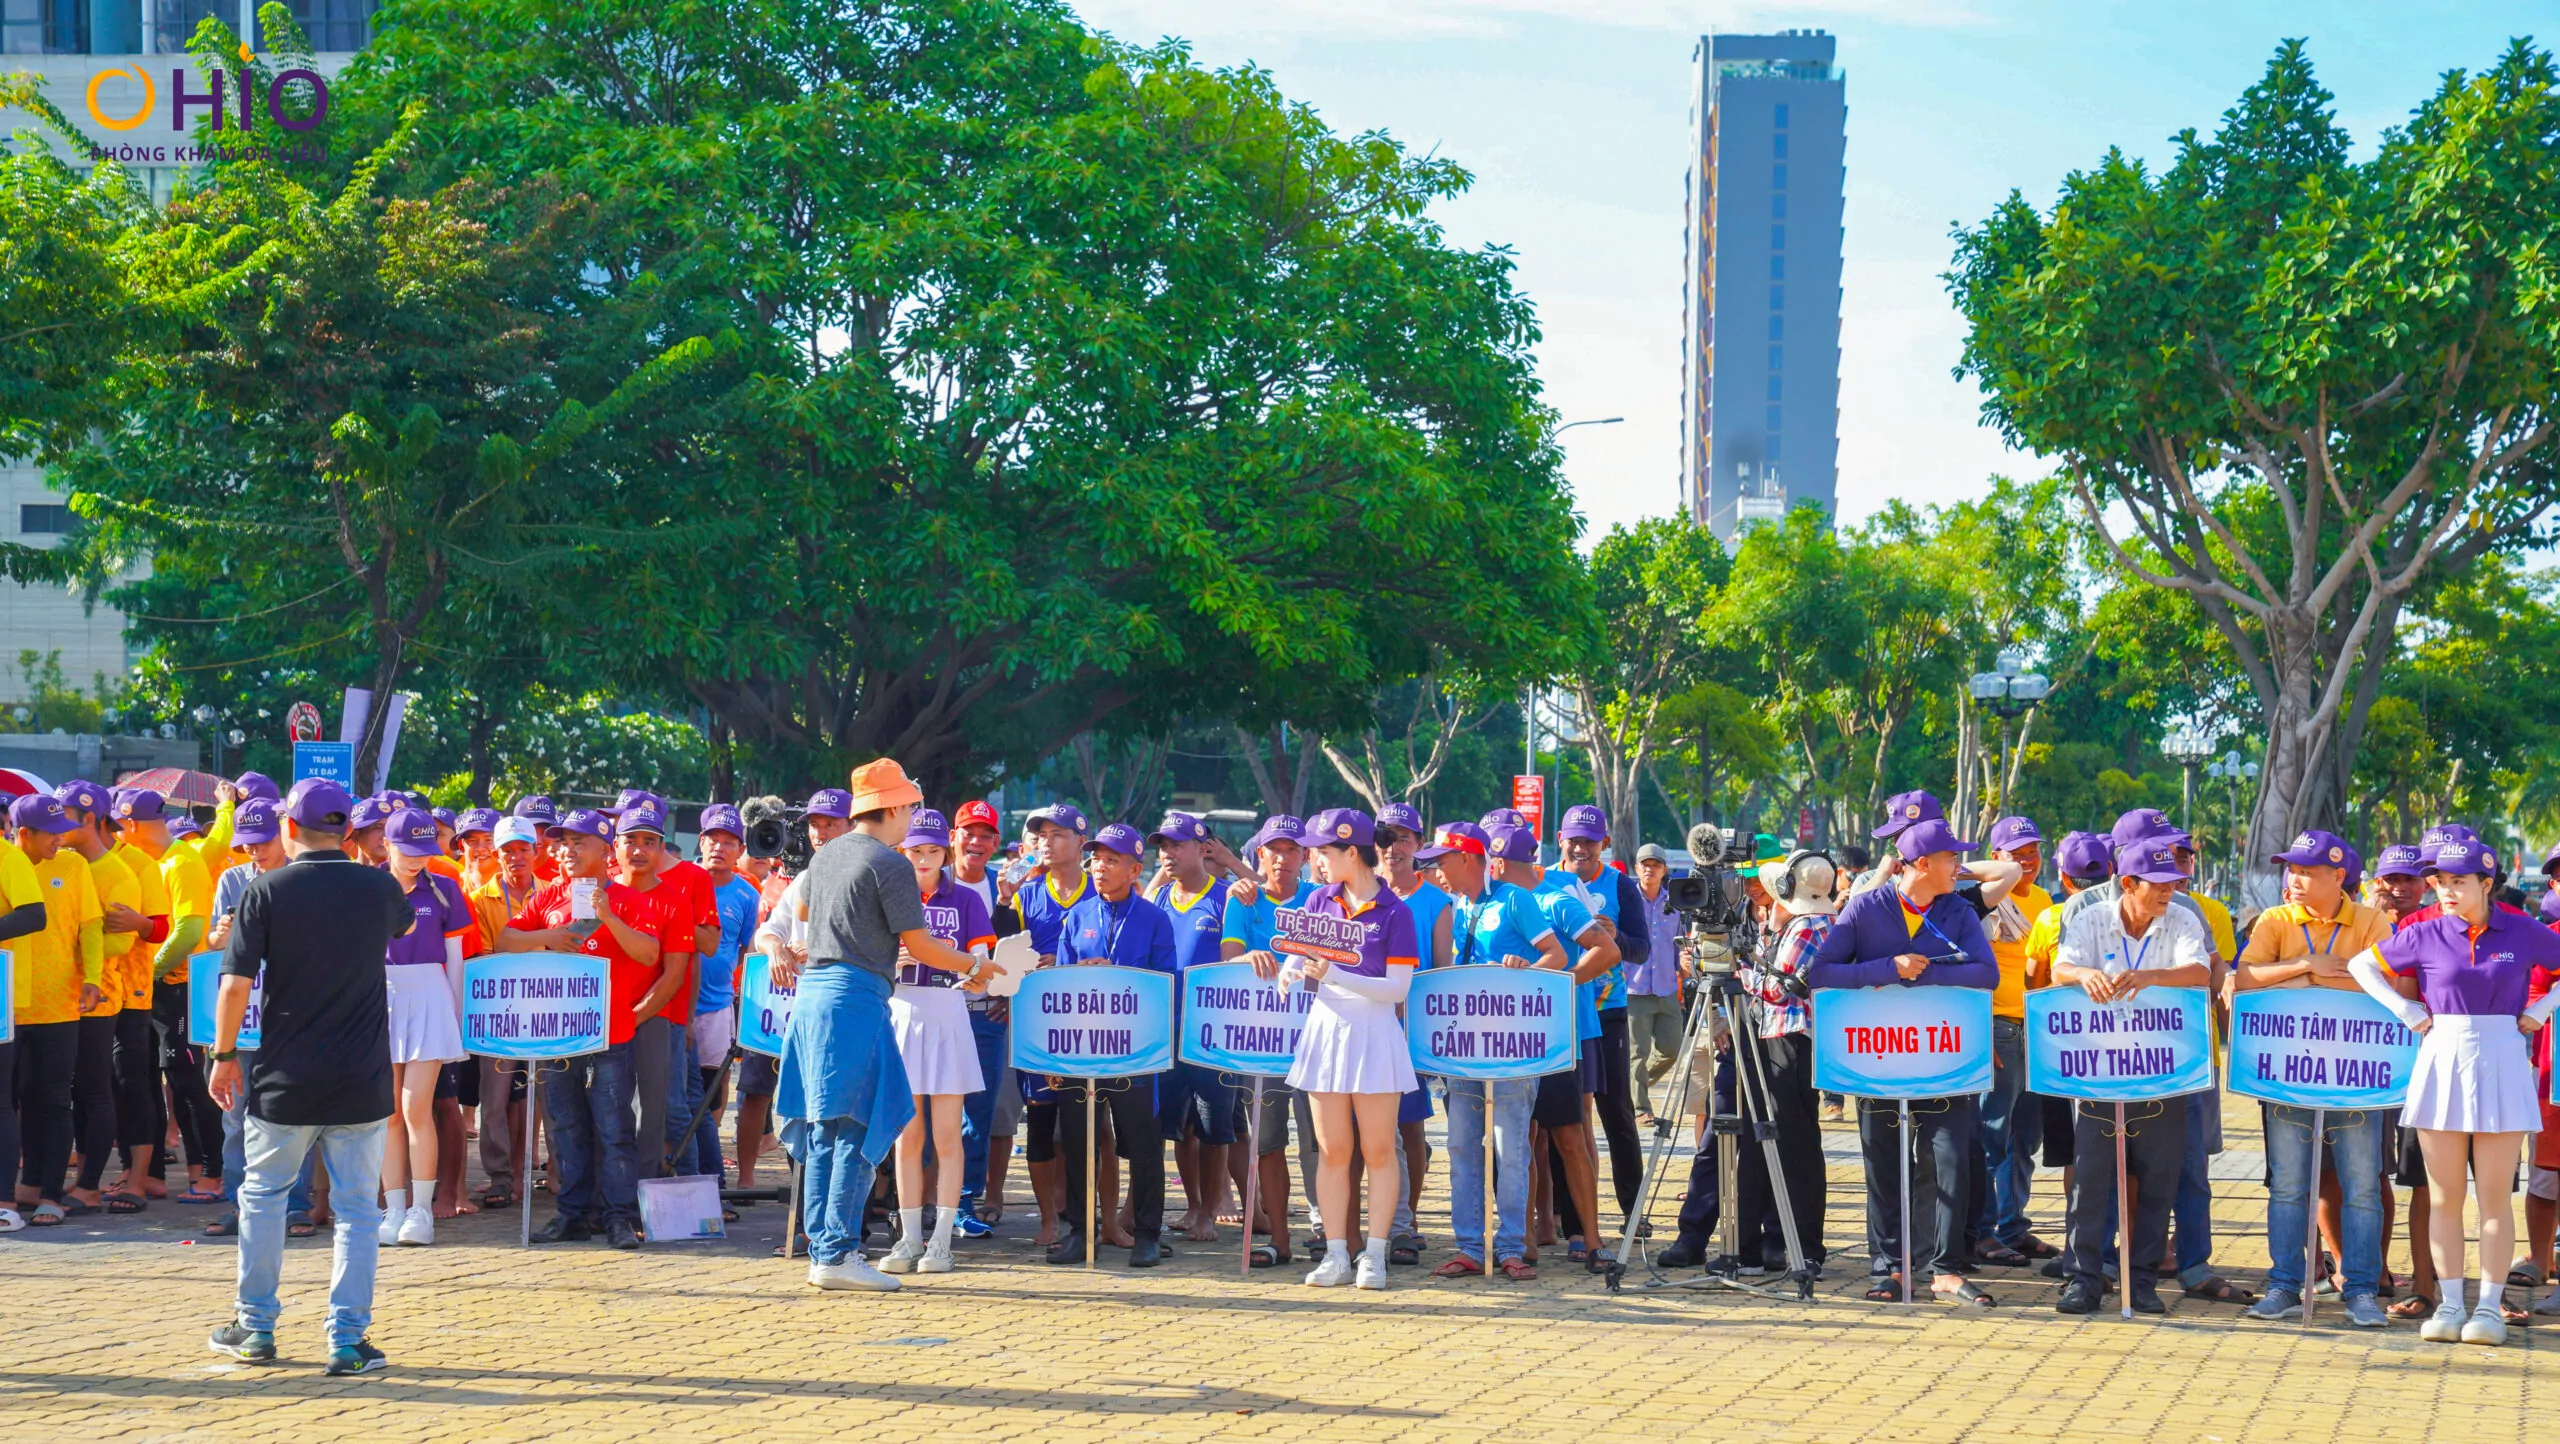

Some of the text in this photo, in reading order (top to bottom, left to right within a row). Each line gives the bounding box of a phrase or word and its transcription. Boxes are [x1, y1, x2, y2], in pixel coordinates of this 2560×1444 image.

[237, 812, 263, 823] OHIO
[527, 801, 550, 811] OHIO
[913, 816, 941, 827] OHIO
[936, 911, 956, 927] DA
[1277, 911, 1361, 942] TRẺ HÓA DA
[1292, 930, 1344, 949] Toàn diện
[472, 972, 600, 1000] CLB ĐT THANH NIÊN
[1195, 986, 1250, 1011] TRUNG
[1256, 986, 1291, 1013] TÂM
[1041, 986, 1138, 1015] CLB BÃI BỒI
[1425, 987, 1552, 1017] CLB ĐÔNG HẢI
[468, 1013, 485, 1044] THỊ
[489, 1004, 520, 1037] TRẤN
[531, 1012, 559, 1038] NAM
[562, 1007, 601, 1037] PHƯỚC
[761, 1008, 777, 1036] Q.
[2048, 1011, 2082, 1035] CLB
[2089, 1010, 2115, 1034] AN
[2240, 1012, 2296, 1039] TRUNG
[2300, 1012, 2337, 1041] TÂM
[1048, 1029, 1131, 1055] DUY VINH
[1200, 1022, 1218, 1052] Q.
[1224, 1024, 1285, 1053] THANH
[1431, 1020, 1546, 1059] CẨM THANH
[1844, 1020, 1961, 1060] TRỌNG TÀI
[2060, 1042, 2175, 1078] DUY THÀNH
[2257, 1049, 2392, 1090] H. HÒA VANG
